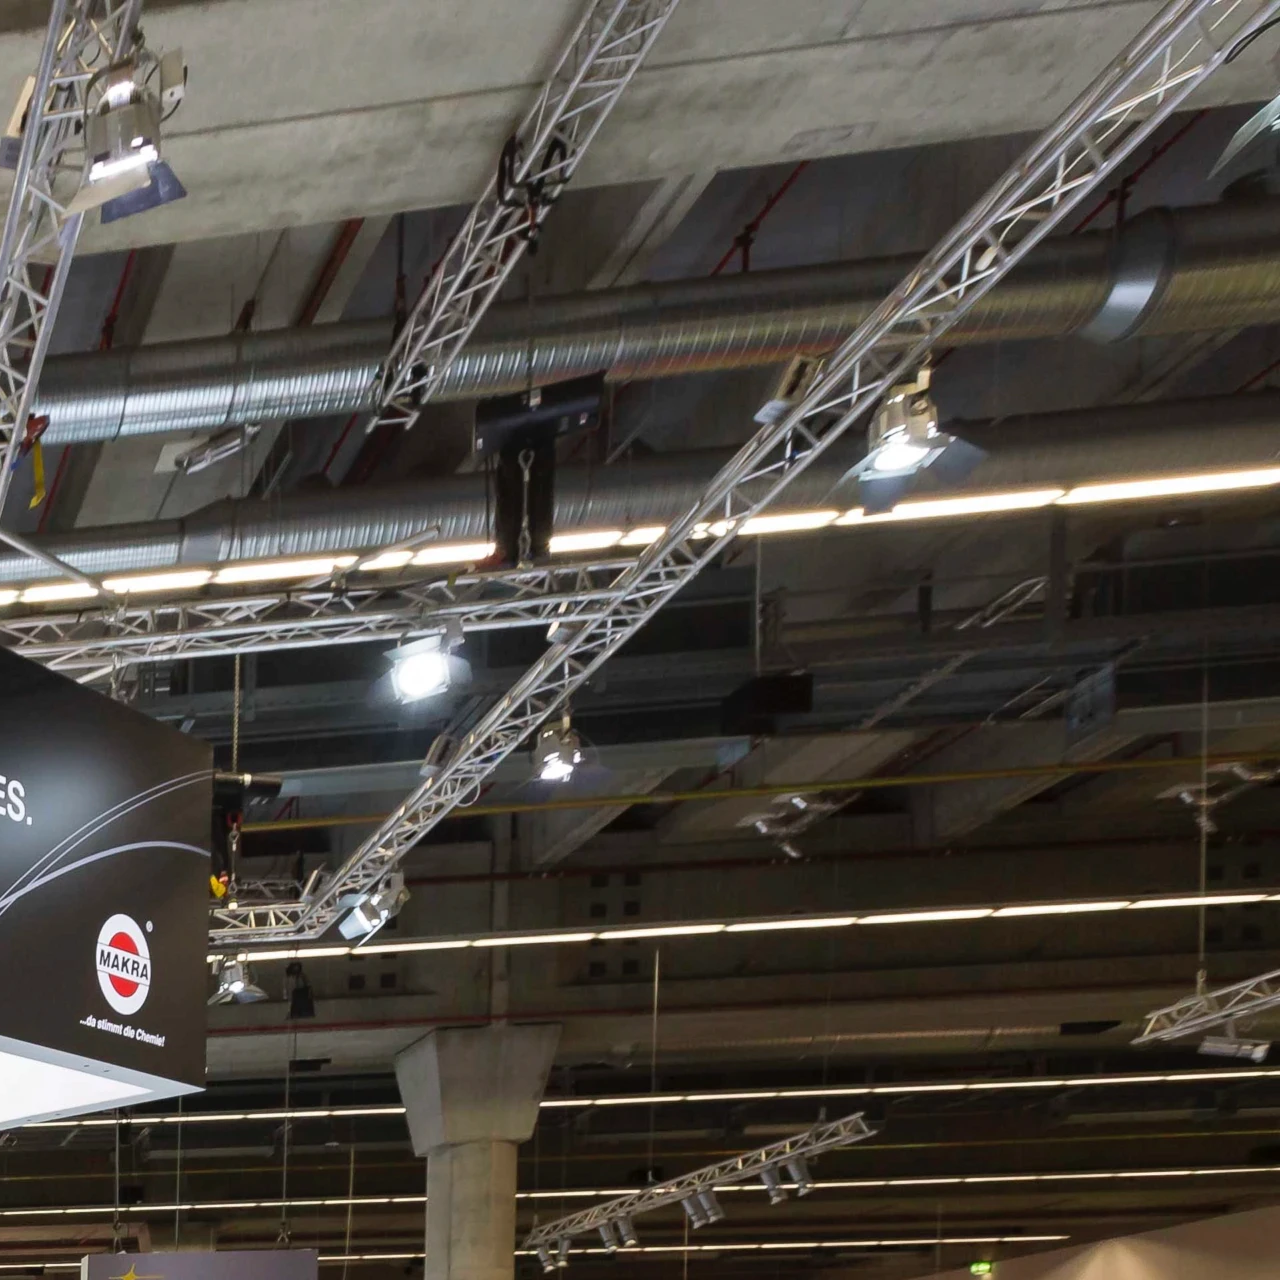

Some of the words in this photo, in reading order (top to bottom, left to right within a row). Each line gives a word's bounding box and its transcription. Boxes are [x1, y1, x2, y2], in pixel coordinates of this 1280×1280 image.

[99, 949, 149, 980] MAKRA
[96, 1018, 123, 1035] stimmt
[123, 1025, 135, 1038] die
[135, 1028, 166, 1047] Chemie!
